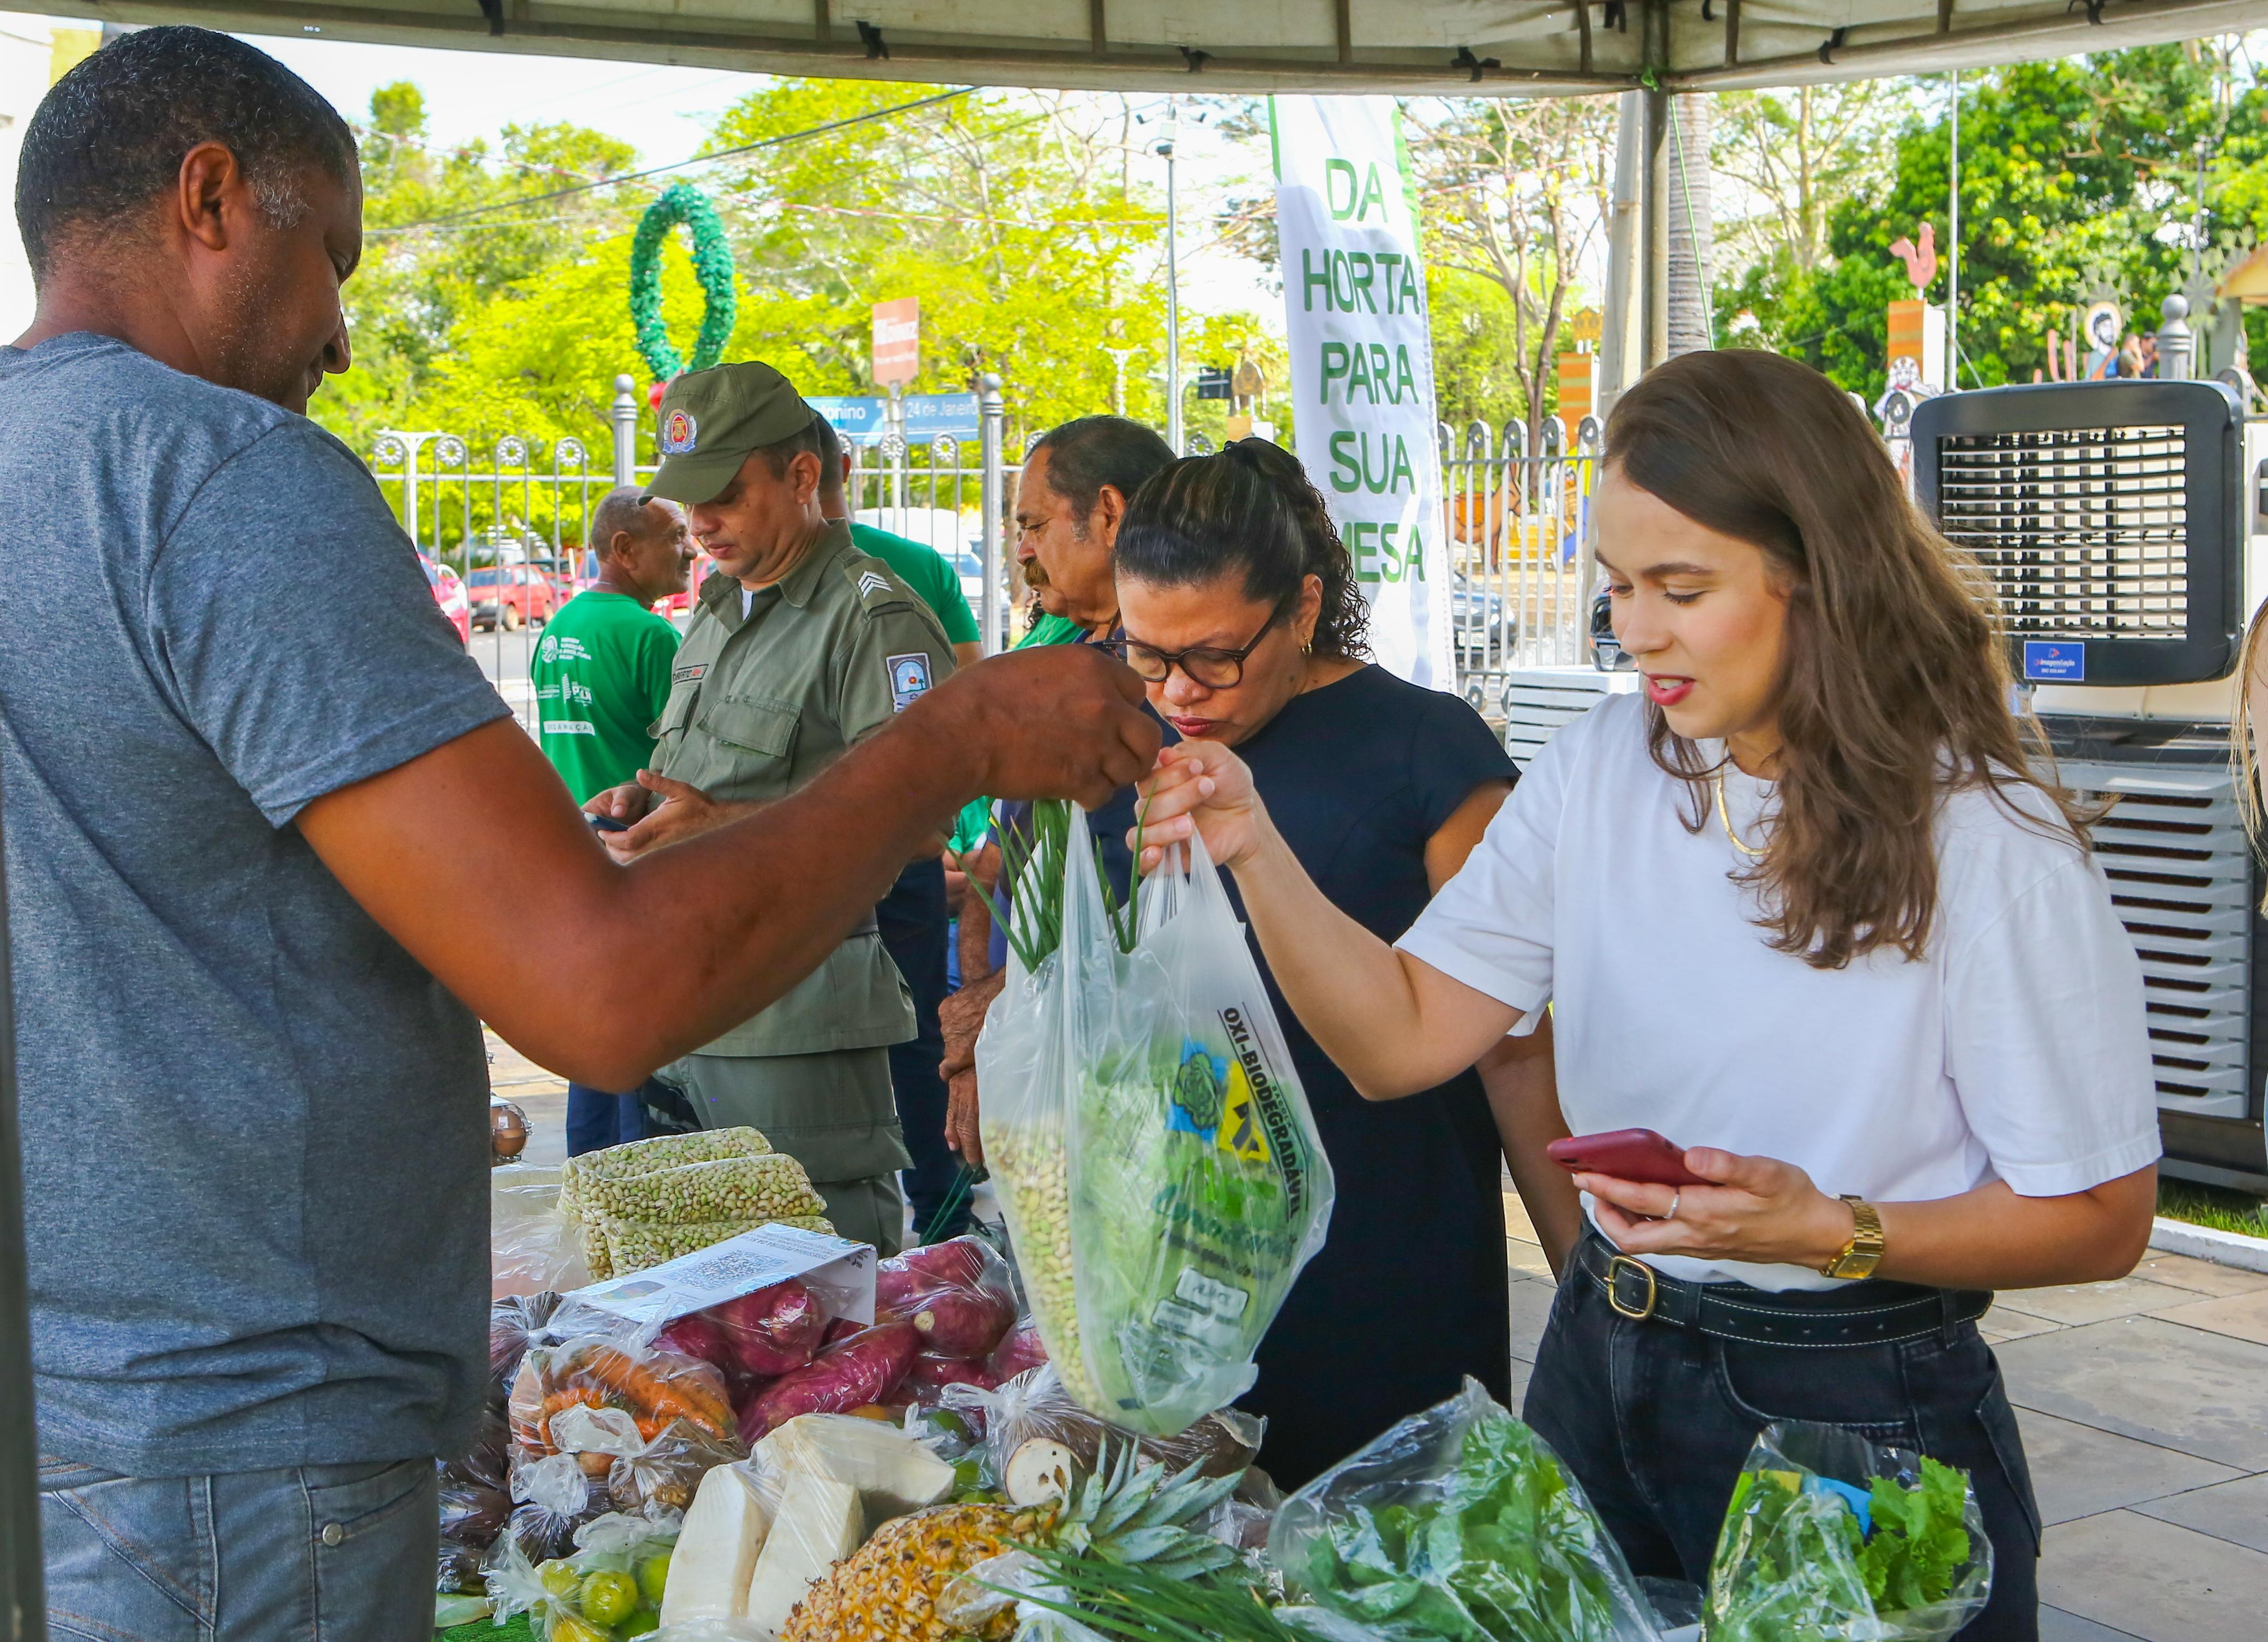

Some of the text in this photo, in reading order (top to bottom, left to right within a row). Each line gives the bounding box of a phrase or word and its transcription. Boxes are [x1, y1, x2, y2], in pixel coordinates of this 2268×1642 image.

[1326, 158, 1388, 223] DA
[1302, 248, 1420, 315] HORTA
[1321, 342, 1419, 405] PARA
[906, 401, 920, 418] 24
[922, 401, 937, 416] de
[1330, 431, 1416, 494] SUA
[1224, 1007, 1304, 1219] OXI-BIODEGRADÁVEL
